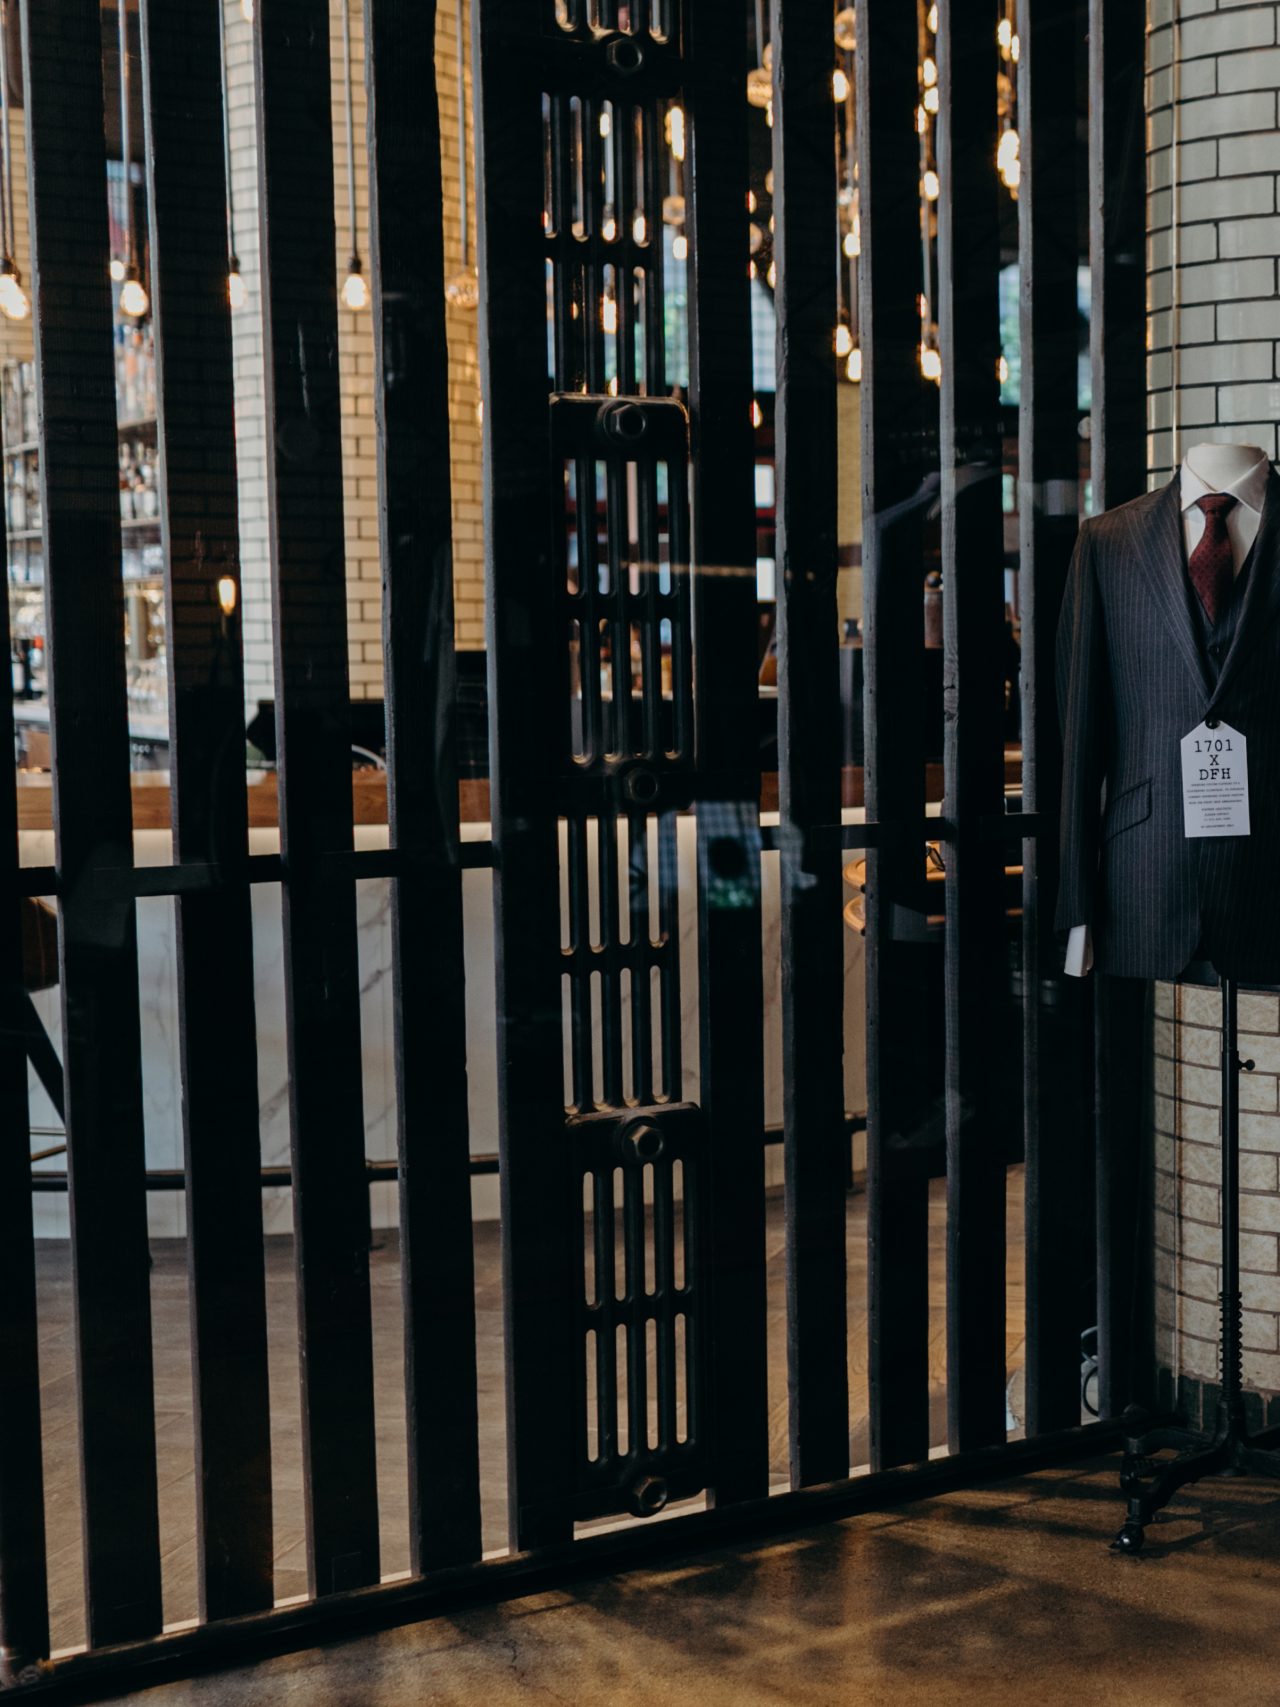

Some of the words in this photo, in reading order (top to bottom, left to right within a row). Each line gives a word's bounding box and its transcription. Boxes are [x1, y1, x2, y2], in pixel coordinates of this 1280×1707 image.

[1194, 739, 1233, 752] 1701
[1209, 754, 1220, 766] X
[1199, 768, 1231, 780] DFH
